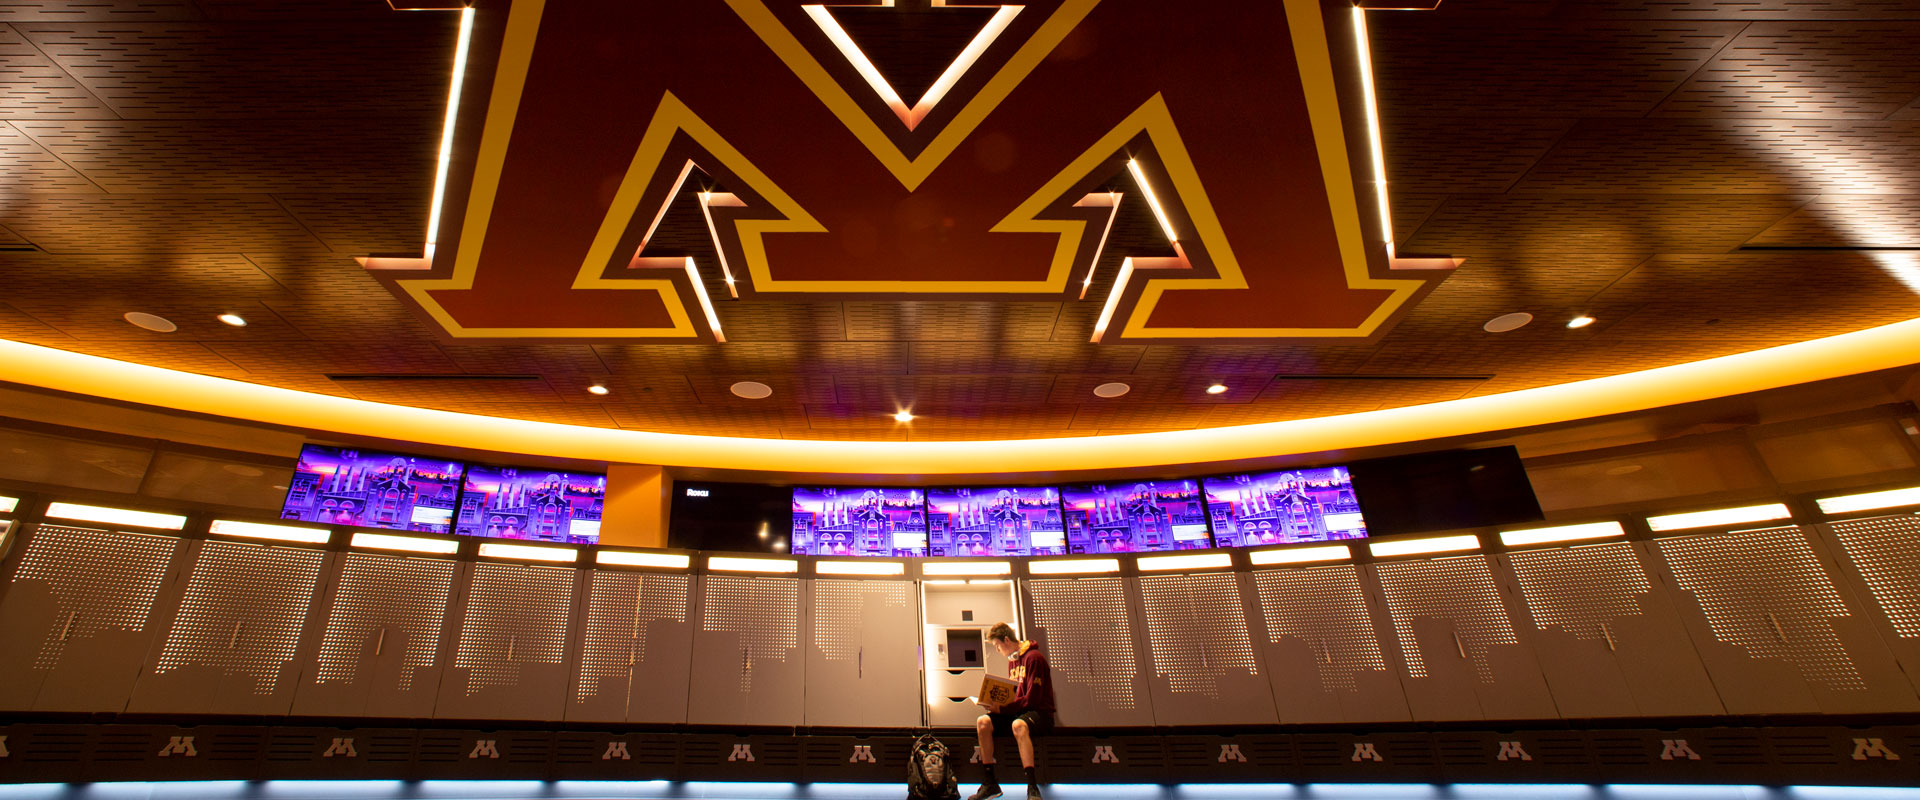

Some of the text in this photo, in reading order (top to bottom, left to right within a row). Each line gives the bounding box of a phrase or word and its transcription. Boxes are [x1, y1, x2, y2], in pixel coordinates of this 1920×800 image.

[390, 0, 1436, 340] M
[159, 737, 196, 756] M
[323, 738, 356, 757] M
[469, 740, 498, 758] M
[603, 742, 630, 760] M
[728, 744, 754, 761] M
[850, 745, 876, 763] M
[1092, 746, 1119, 763] M
[1218, 745, 1247, 762] M
[1352, 744, 1383, 761] M
[1498, 742, 1532, 760] M
[1661, 740, 1700, 760] M
[1852, 739, 1899, 760] M
